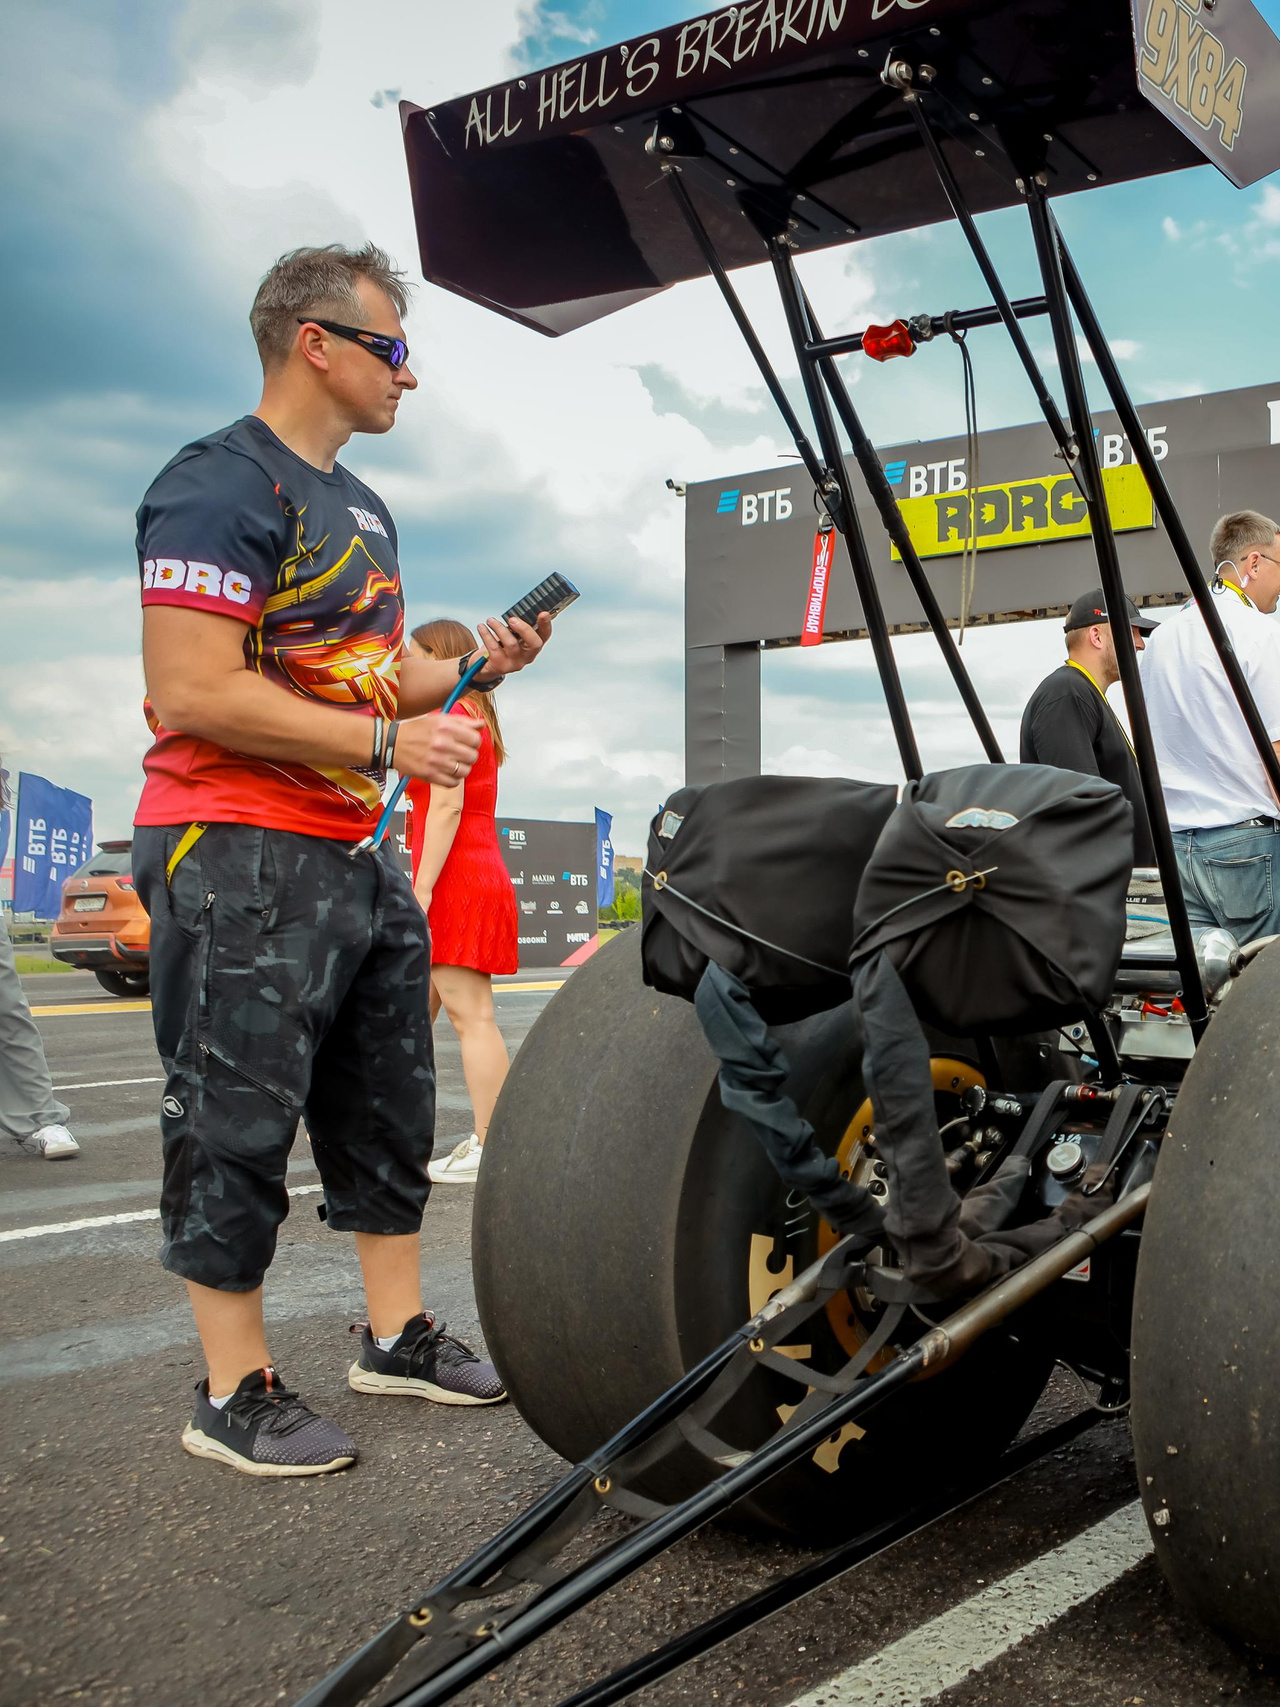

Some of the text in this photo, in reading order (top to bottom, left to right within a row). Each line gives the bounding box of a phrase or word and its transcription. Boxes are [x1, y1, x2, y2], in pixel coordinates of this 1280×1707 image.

[465, 96, 522, 149] ALL
[538, 38, 661, 131] HELL'S
[1138, 0, 1247, 152] 9X84
[909, 458, 967, 498] ВТБ
[741, 487, 793, 526] ВТБ
[934, 477, 1089, 543] RDRC
[805, 566, 827, 634] СПОРТИВНАЯ
[509, 830, 526, 841] ВТБ
[531, 874, 556, 883] MAXIM
[570, 874, 588, 886] ВТБ
